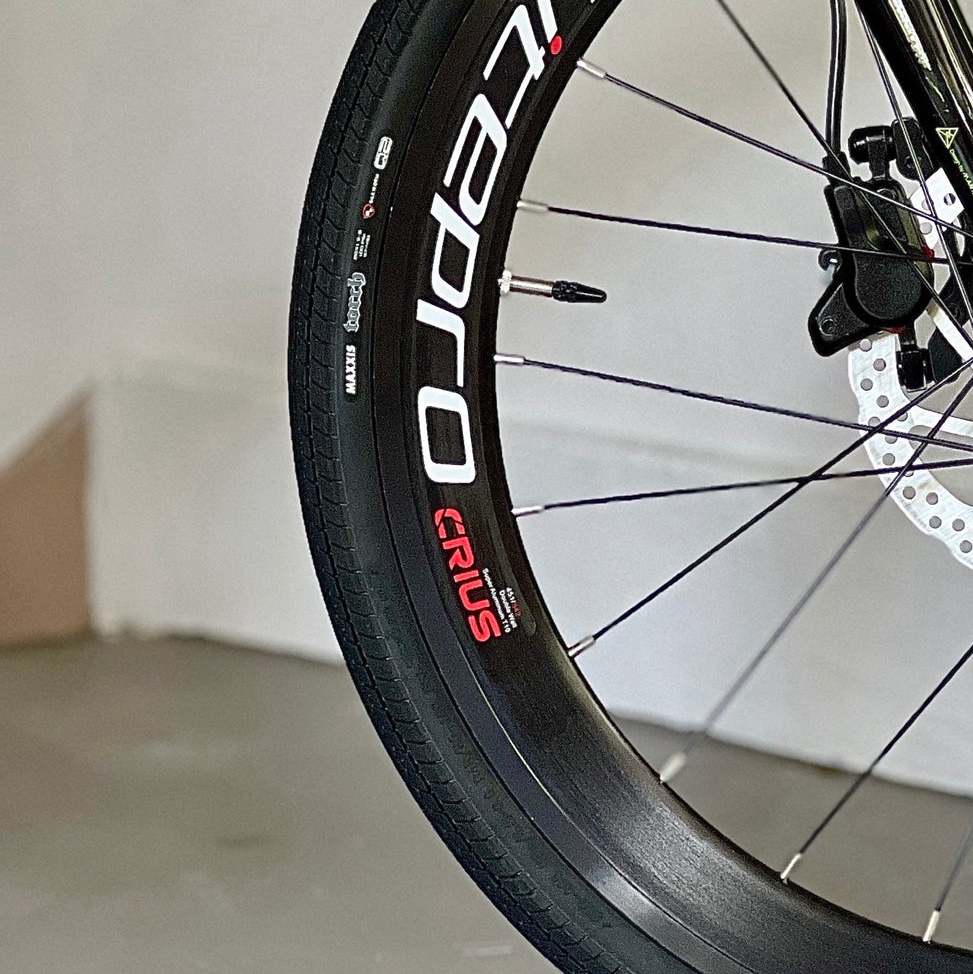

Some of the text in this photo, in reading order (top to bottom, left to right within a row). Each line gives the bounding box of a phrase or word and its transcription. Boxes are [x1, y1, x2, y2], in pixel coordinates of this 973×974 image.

[343, 272, 366, 332] torch
[345, 344, 357, 395] MAXXIS
[434, 508, 501, 642] CRIUS
